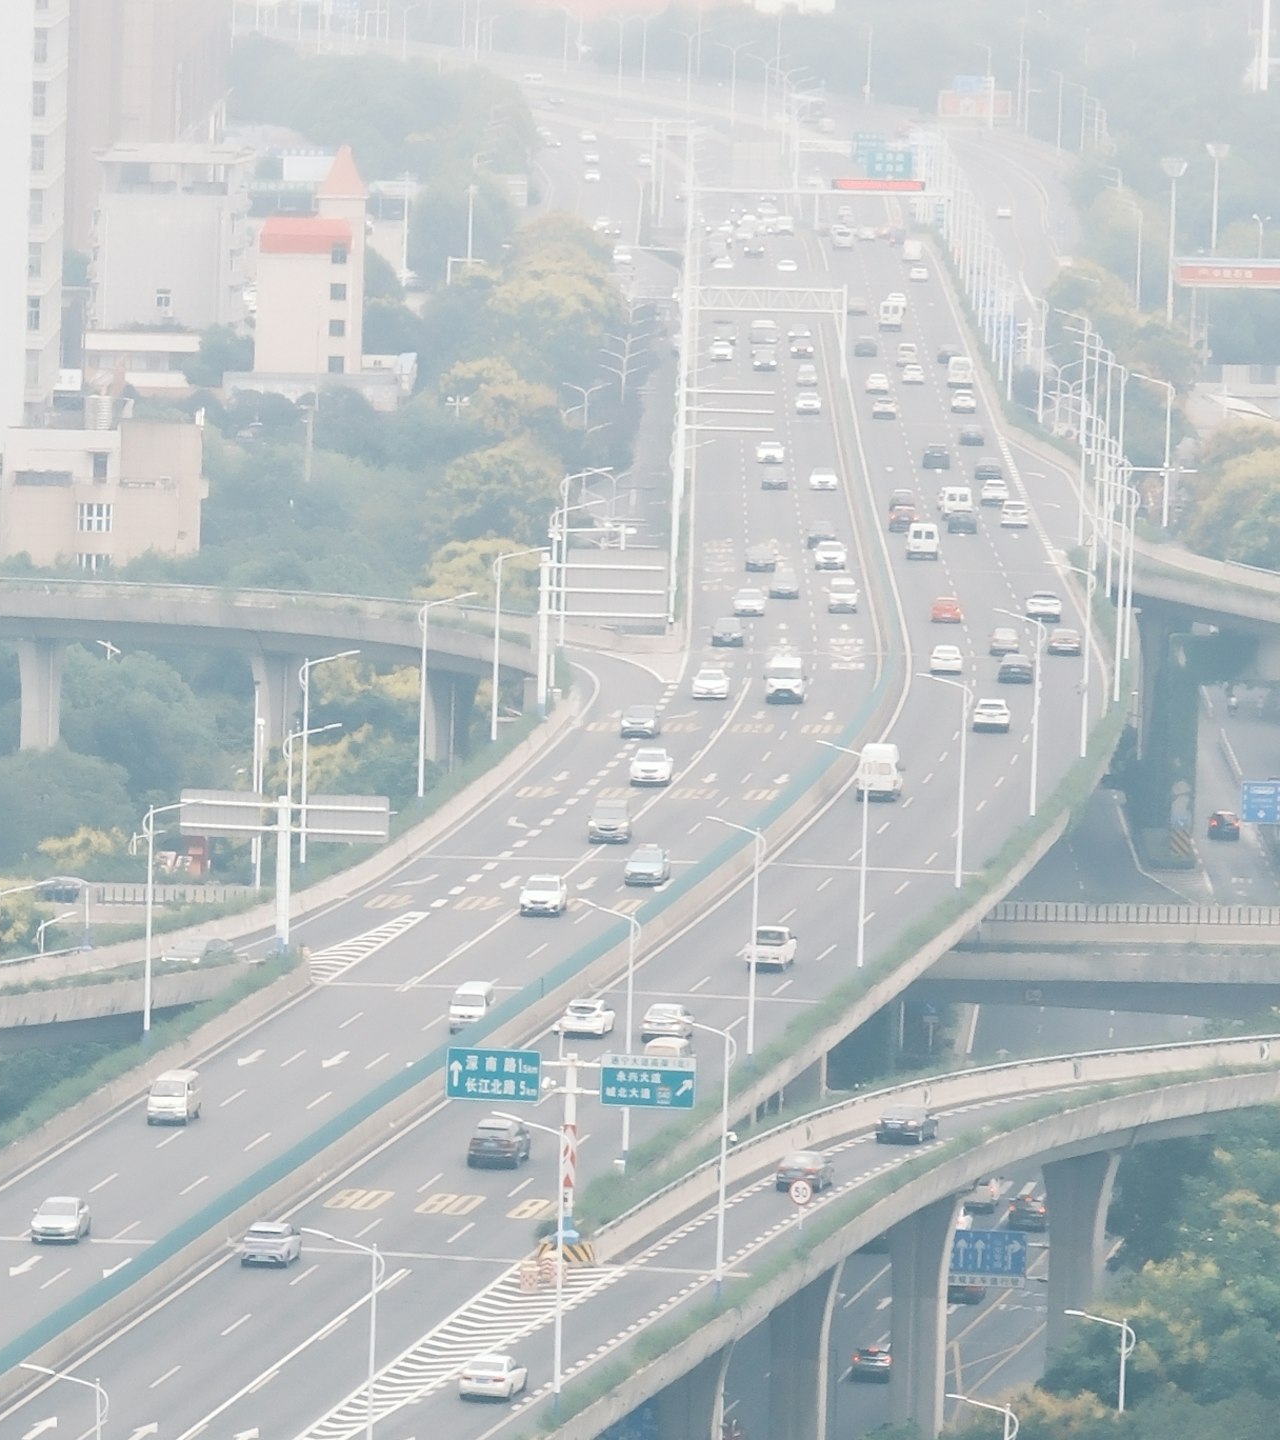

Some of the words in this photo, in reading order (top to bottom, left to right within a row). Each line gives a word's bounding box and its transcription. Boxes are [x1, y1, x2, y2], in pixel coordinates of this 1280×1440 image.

[465, 1077, 516, 1095] 长江北路
[322, 1188, 396, 1210] 80
[414, 1193, 486, 1216] 80
